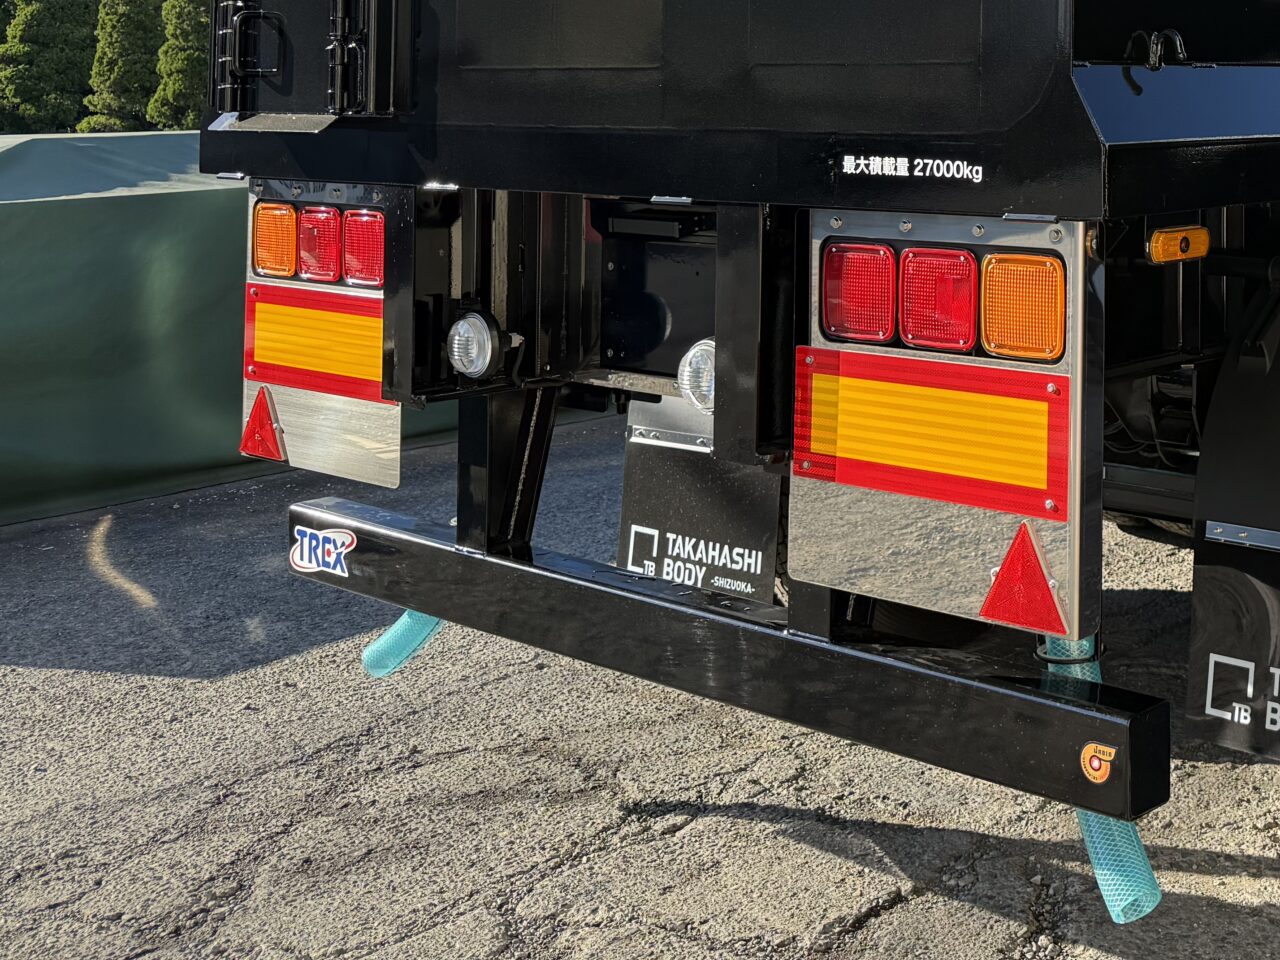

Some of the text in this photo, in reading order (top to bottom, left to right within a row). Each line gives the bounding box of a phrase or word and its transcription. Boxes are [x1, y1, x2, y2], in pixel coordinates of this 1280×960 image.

[843, 155, 983, 183] 最大積載量 27000kg
[296, 528, 346, 574] TREX
[666, 533, 762, 575] TAKAHASHI
[643, 560, 656, 577] TB
[662, 558, 755, 594] BODY -SHIZUOKA-
[1232, 702, 1252, 726] TB
